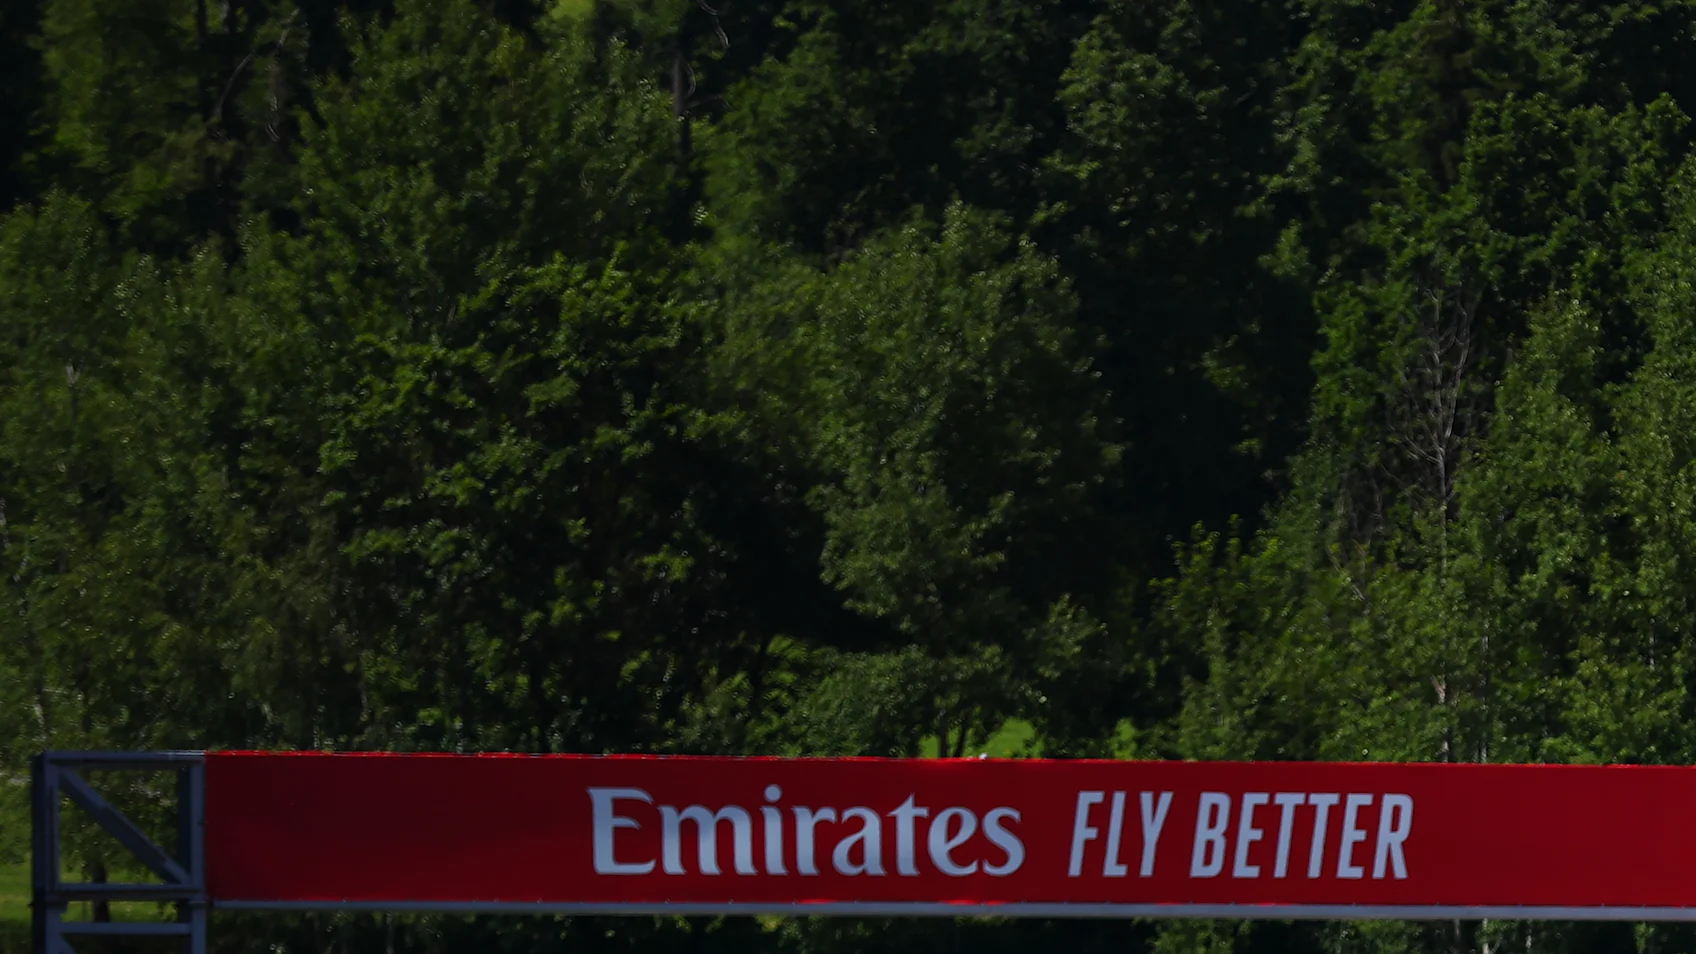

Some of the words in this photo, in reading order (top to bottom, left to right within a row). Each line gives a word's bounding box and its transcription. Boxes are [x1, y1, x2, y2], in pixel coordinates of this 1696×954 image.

[585, 785, 1025, 878] Emirates
[1068, 790, 1174, 878] FLY
[1190, 792, 1414, 880] BETTER
